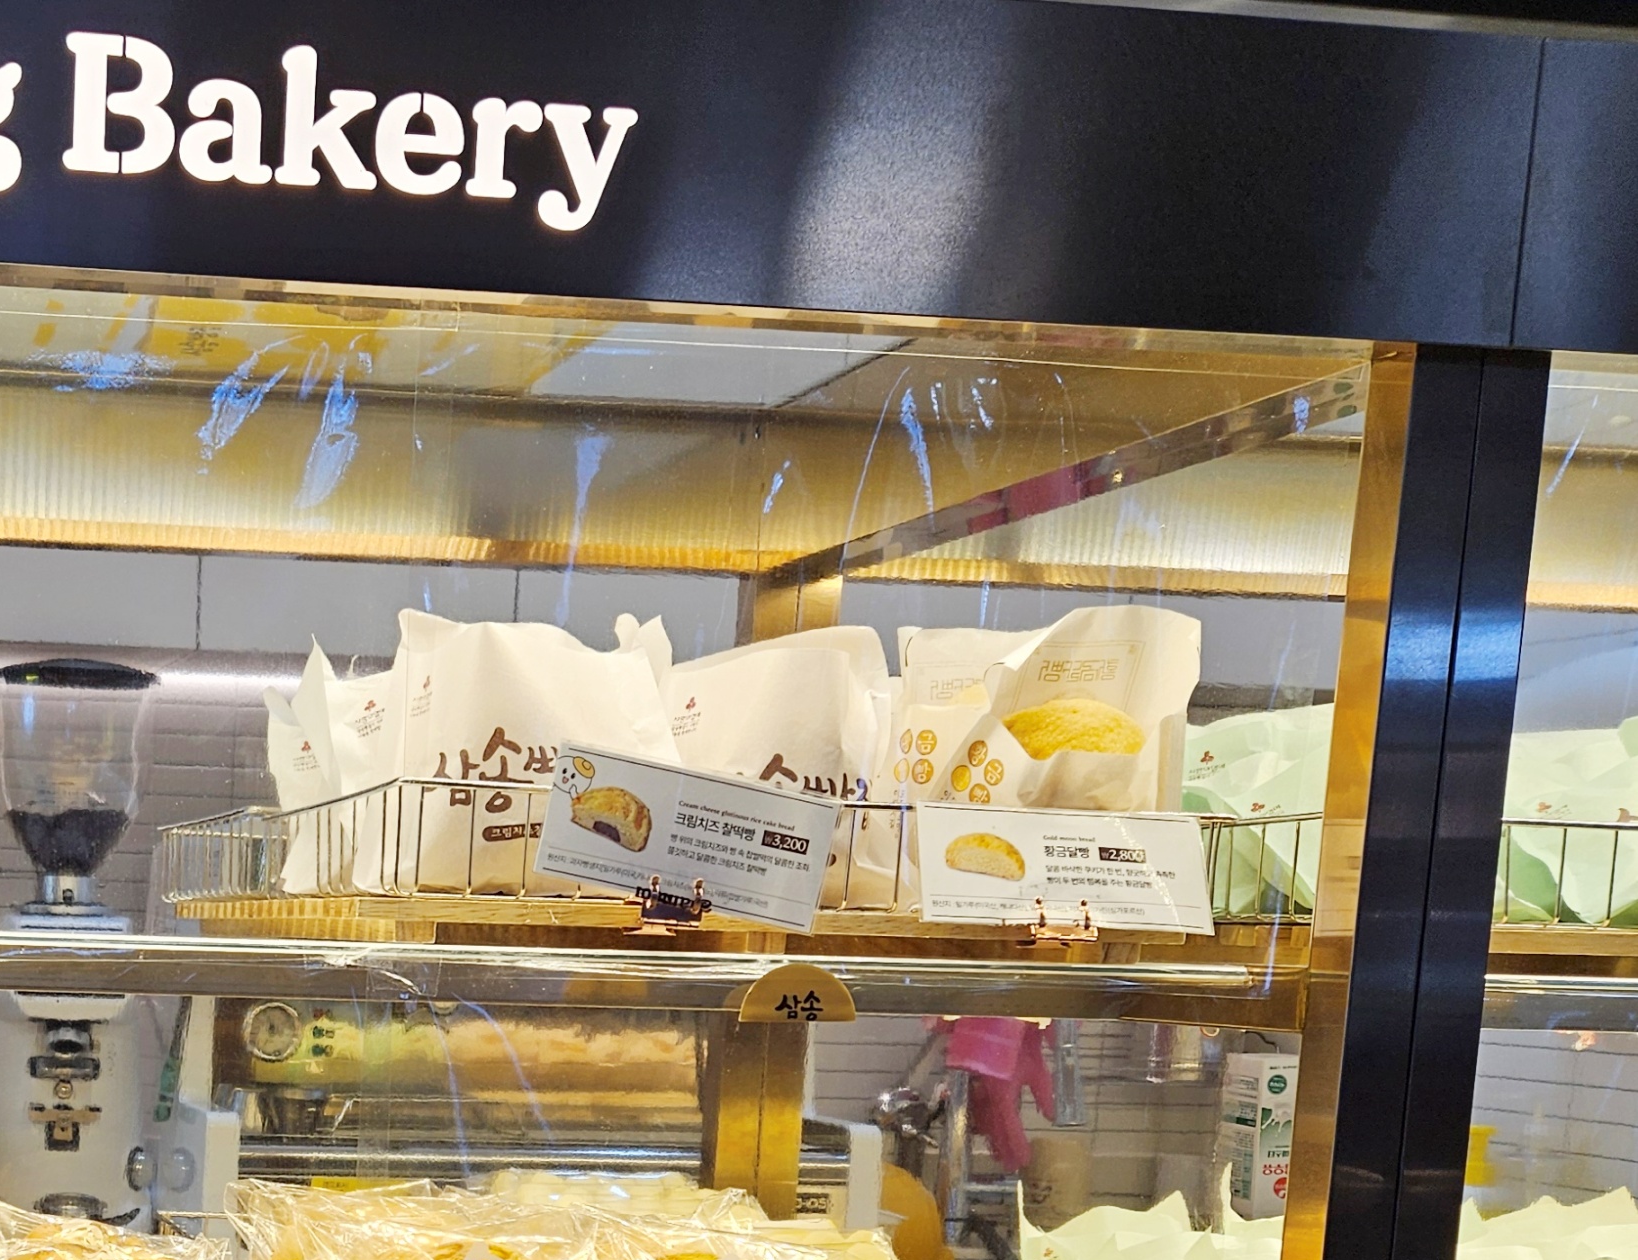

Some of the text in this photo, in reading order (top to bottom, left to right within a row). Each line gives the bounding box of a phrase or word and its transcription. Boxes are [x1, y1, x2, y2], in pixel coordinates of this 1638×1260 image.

[62, 31, 638, 231] Bakery
[675, 812, 720, 833] 크림치즈
[722, 822, 756, 842] 찰떡빵
[679, 800, 698, 810] Cream
[700, 804, 720, 815] cheese
[778, 823, 794, 831] bread
[1044, 845, 1090, 858] 황금달빵
[775, 991, 823, 1020] 삼송
